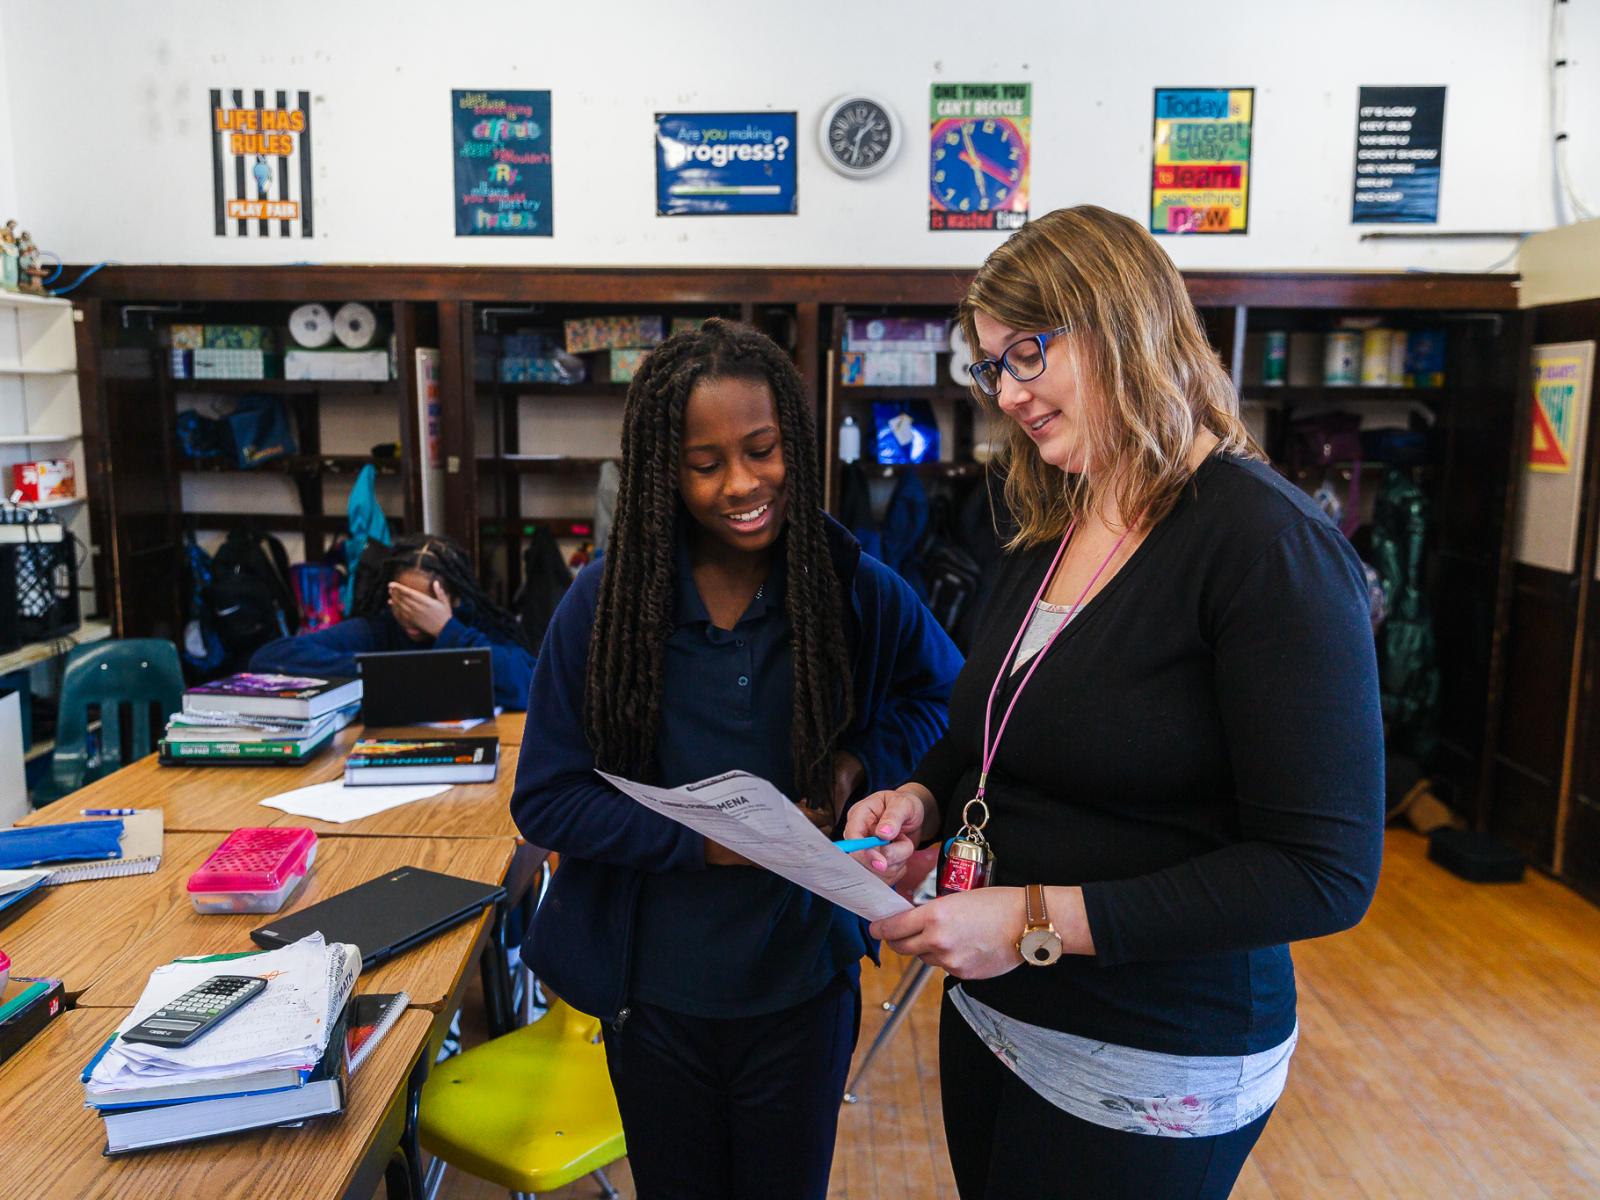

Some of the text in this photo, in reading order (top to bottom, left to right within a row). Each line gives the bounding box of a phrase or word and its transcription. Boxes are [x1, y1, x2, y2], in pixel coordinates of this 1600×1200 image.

[935, 86, 1027, 99] ONE THING YOU
[937, 100, 1023, 115] CAN'T RECYCLE
[1162, 95, 1225, 119] Today
[1384, 106, 1417, 117] LOW
[216, 108, 305, 132] LIFE HAS
[1359, 120, 1386, 131] KEY
[677, 124, 773, 144] Are you making
[1176, 121, 1246, 149] great
[1359, 135, 1397, 145] WHEN
[231, 133, 293, 155] RULES
[665, 136, 790, 168] rogress?
[1188, 141, 1226, 162] day
[1358, 149, 1438, 159] DON'T SHOW
[1159, 165, 1241, 188] to learn
[523, 199, 541, 212] try
[1161, 192, 1242, 208] something
[1355, 192, 1375, 202] NO
[230, 202, 296, 217] PLAY FAIR
[1172, 208, 1231, 229] new
[338, 969, 355, 999] MATH
